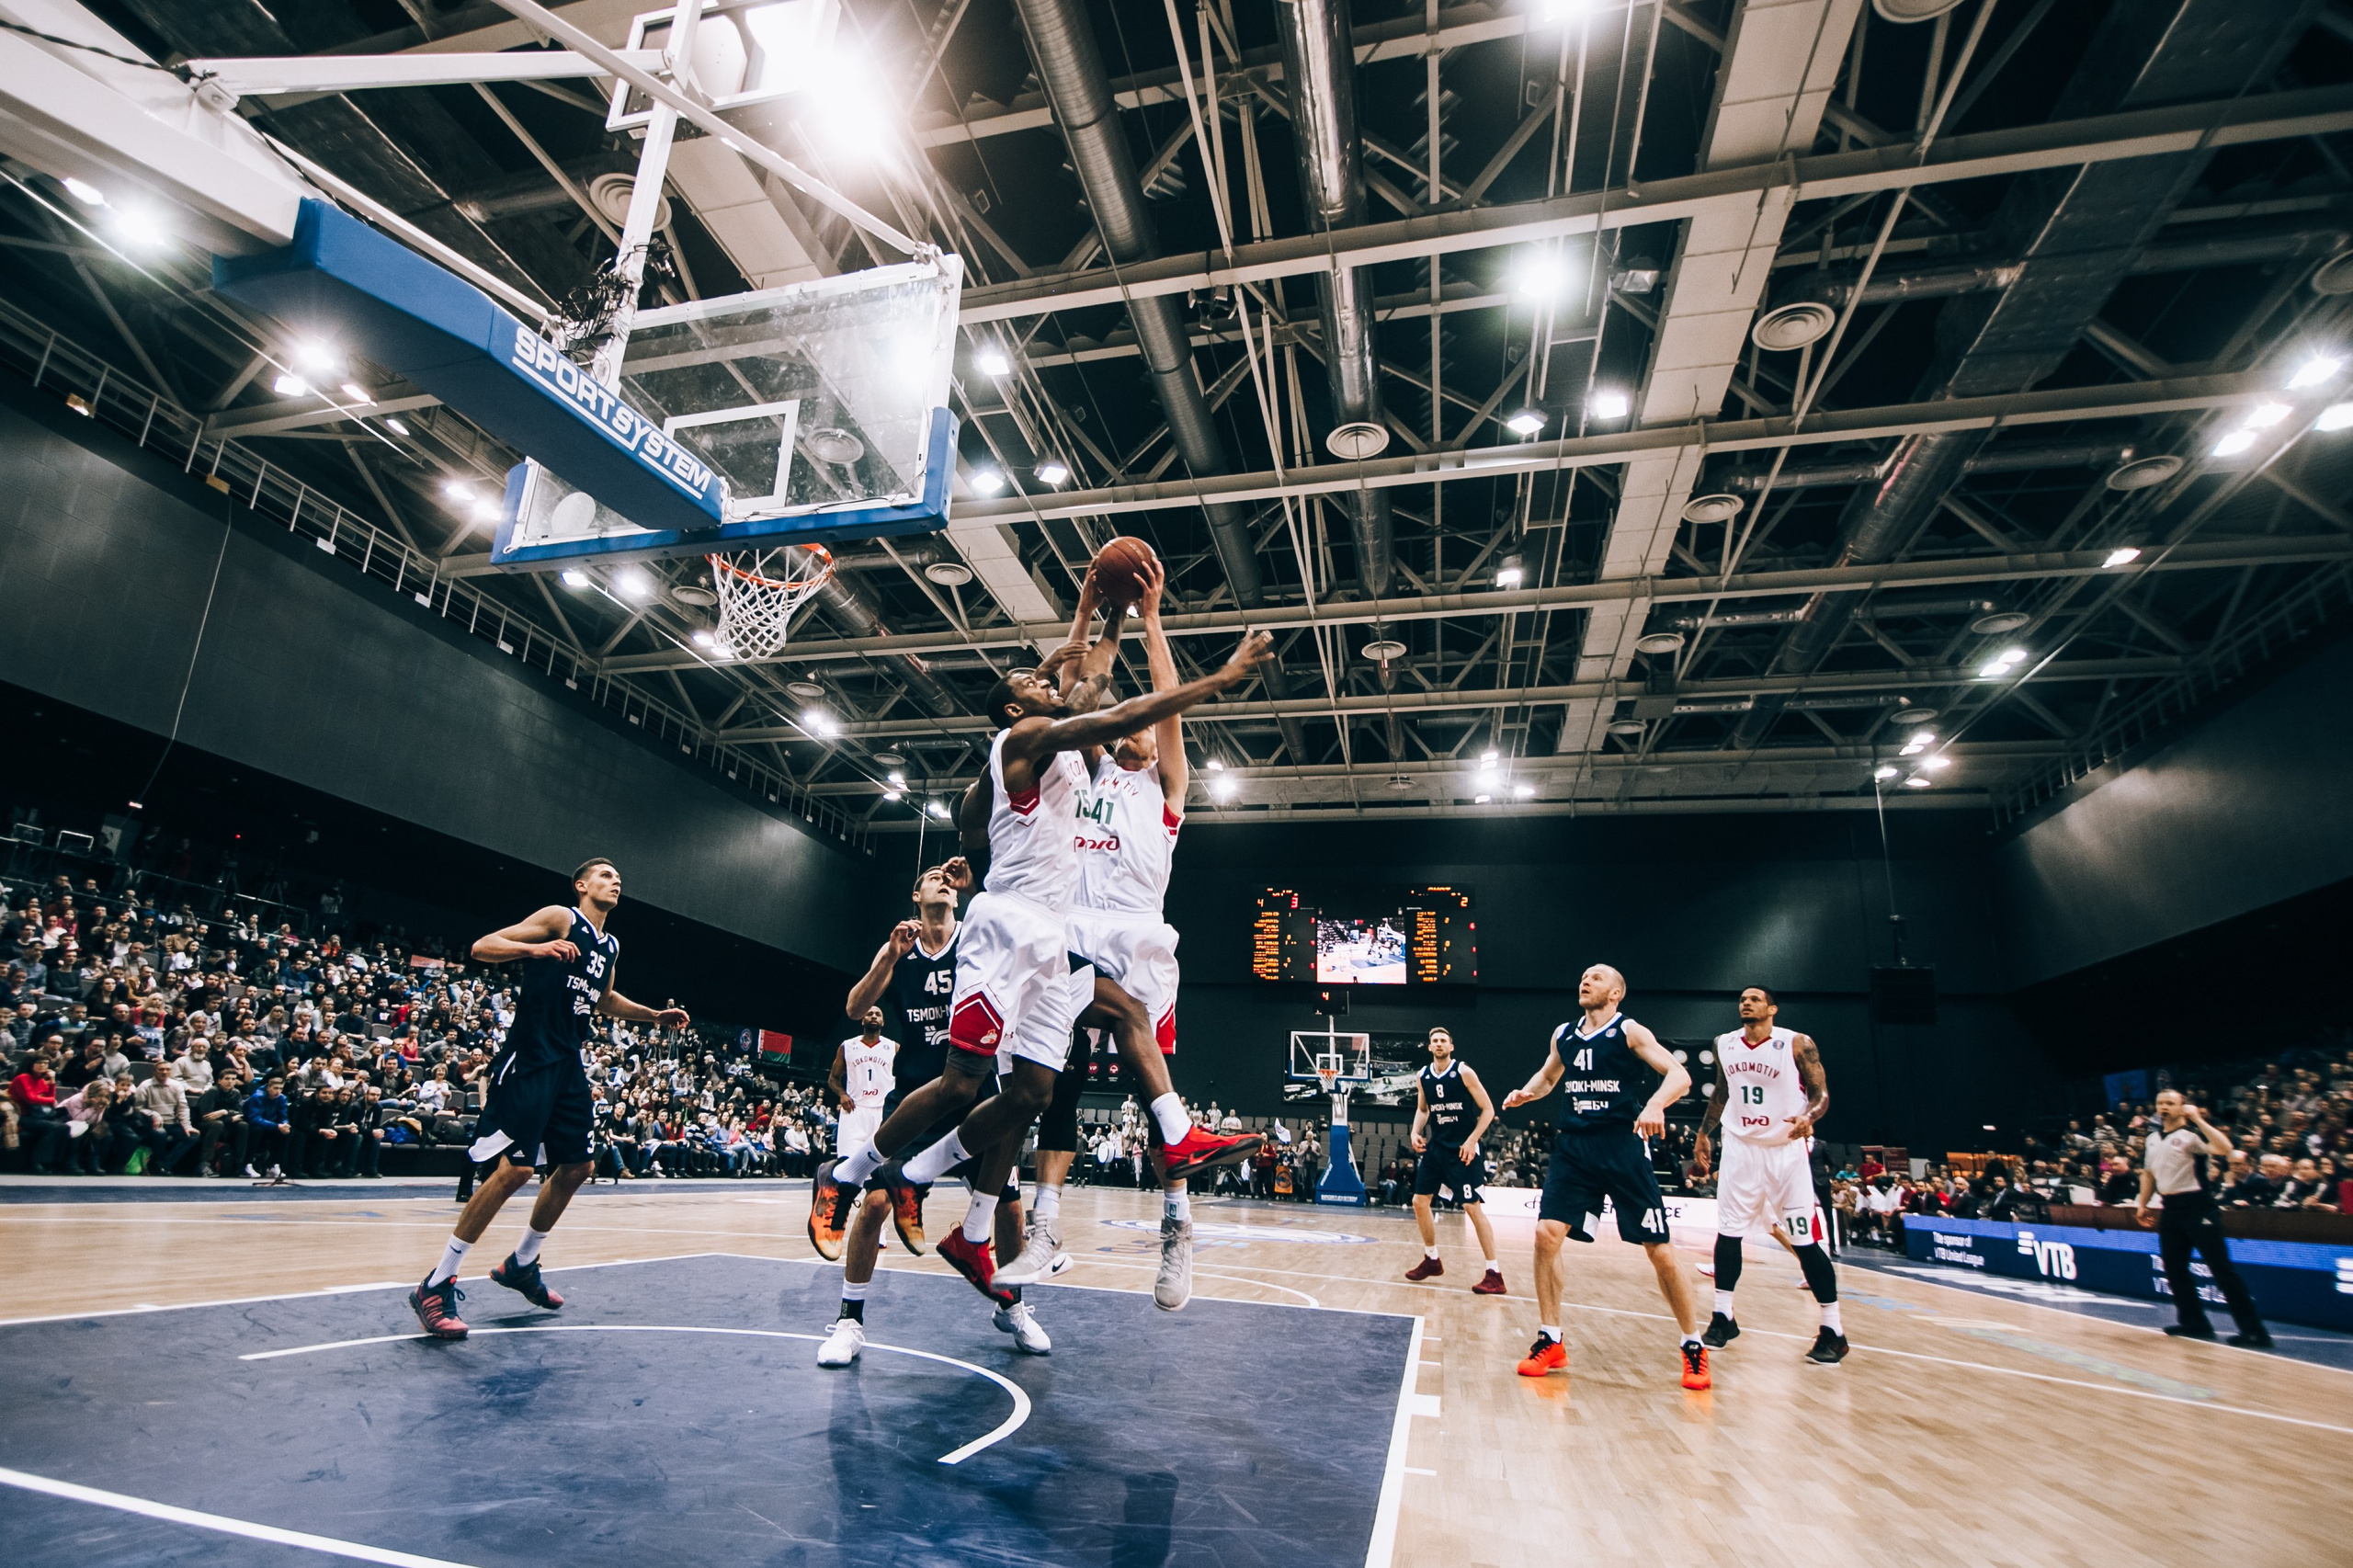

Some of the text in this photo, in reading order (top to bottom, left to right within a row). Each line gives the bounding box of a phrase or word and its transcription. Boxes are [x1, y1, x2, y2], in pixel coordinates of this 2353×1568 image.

[1074, 790, 1091, 819] 15
[1091, 798, 1115, 825] 41
[1461, 896, 1469, 907] 2
[586, 950, 607, 979] 35
[924, 969, 953, 995] 45
[852, 1055, 888, 1067] LOKOMOTIV
[1573, 1048, 1593, 1071] 41
[867, 1068, 873, 1082] 1
[1436, 1084, 1445, 1098] 8
[1740, 1085, 1764, 1105] 19
[1462, 1183, 1473, 1199] 8
[1641, 1208, 1665, 1233] 41
[1785, 1216, 1809, 1236] 19
[1943, 1234, 1965, 1247] sponsor
[1933, 1246, 1947, 1261] VTB
[1946, 1249, 1964, 1263] United
[2033, 1240, 2078, 1280] VTB
